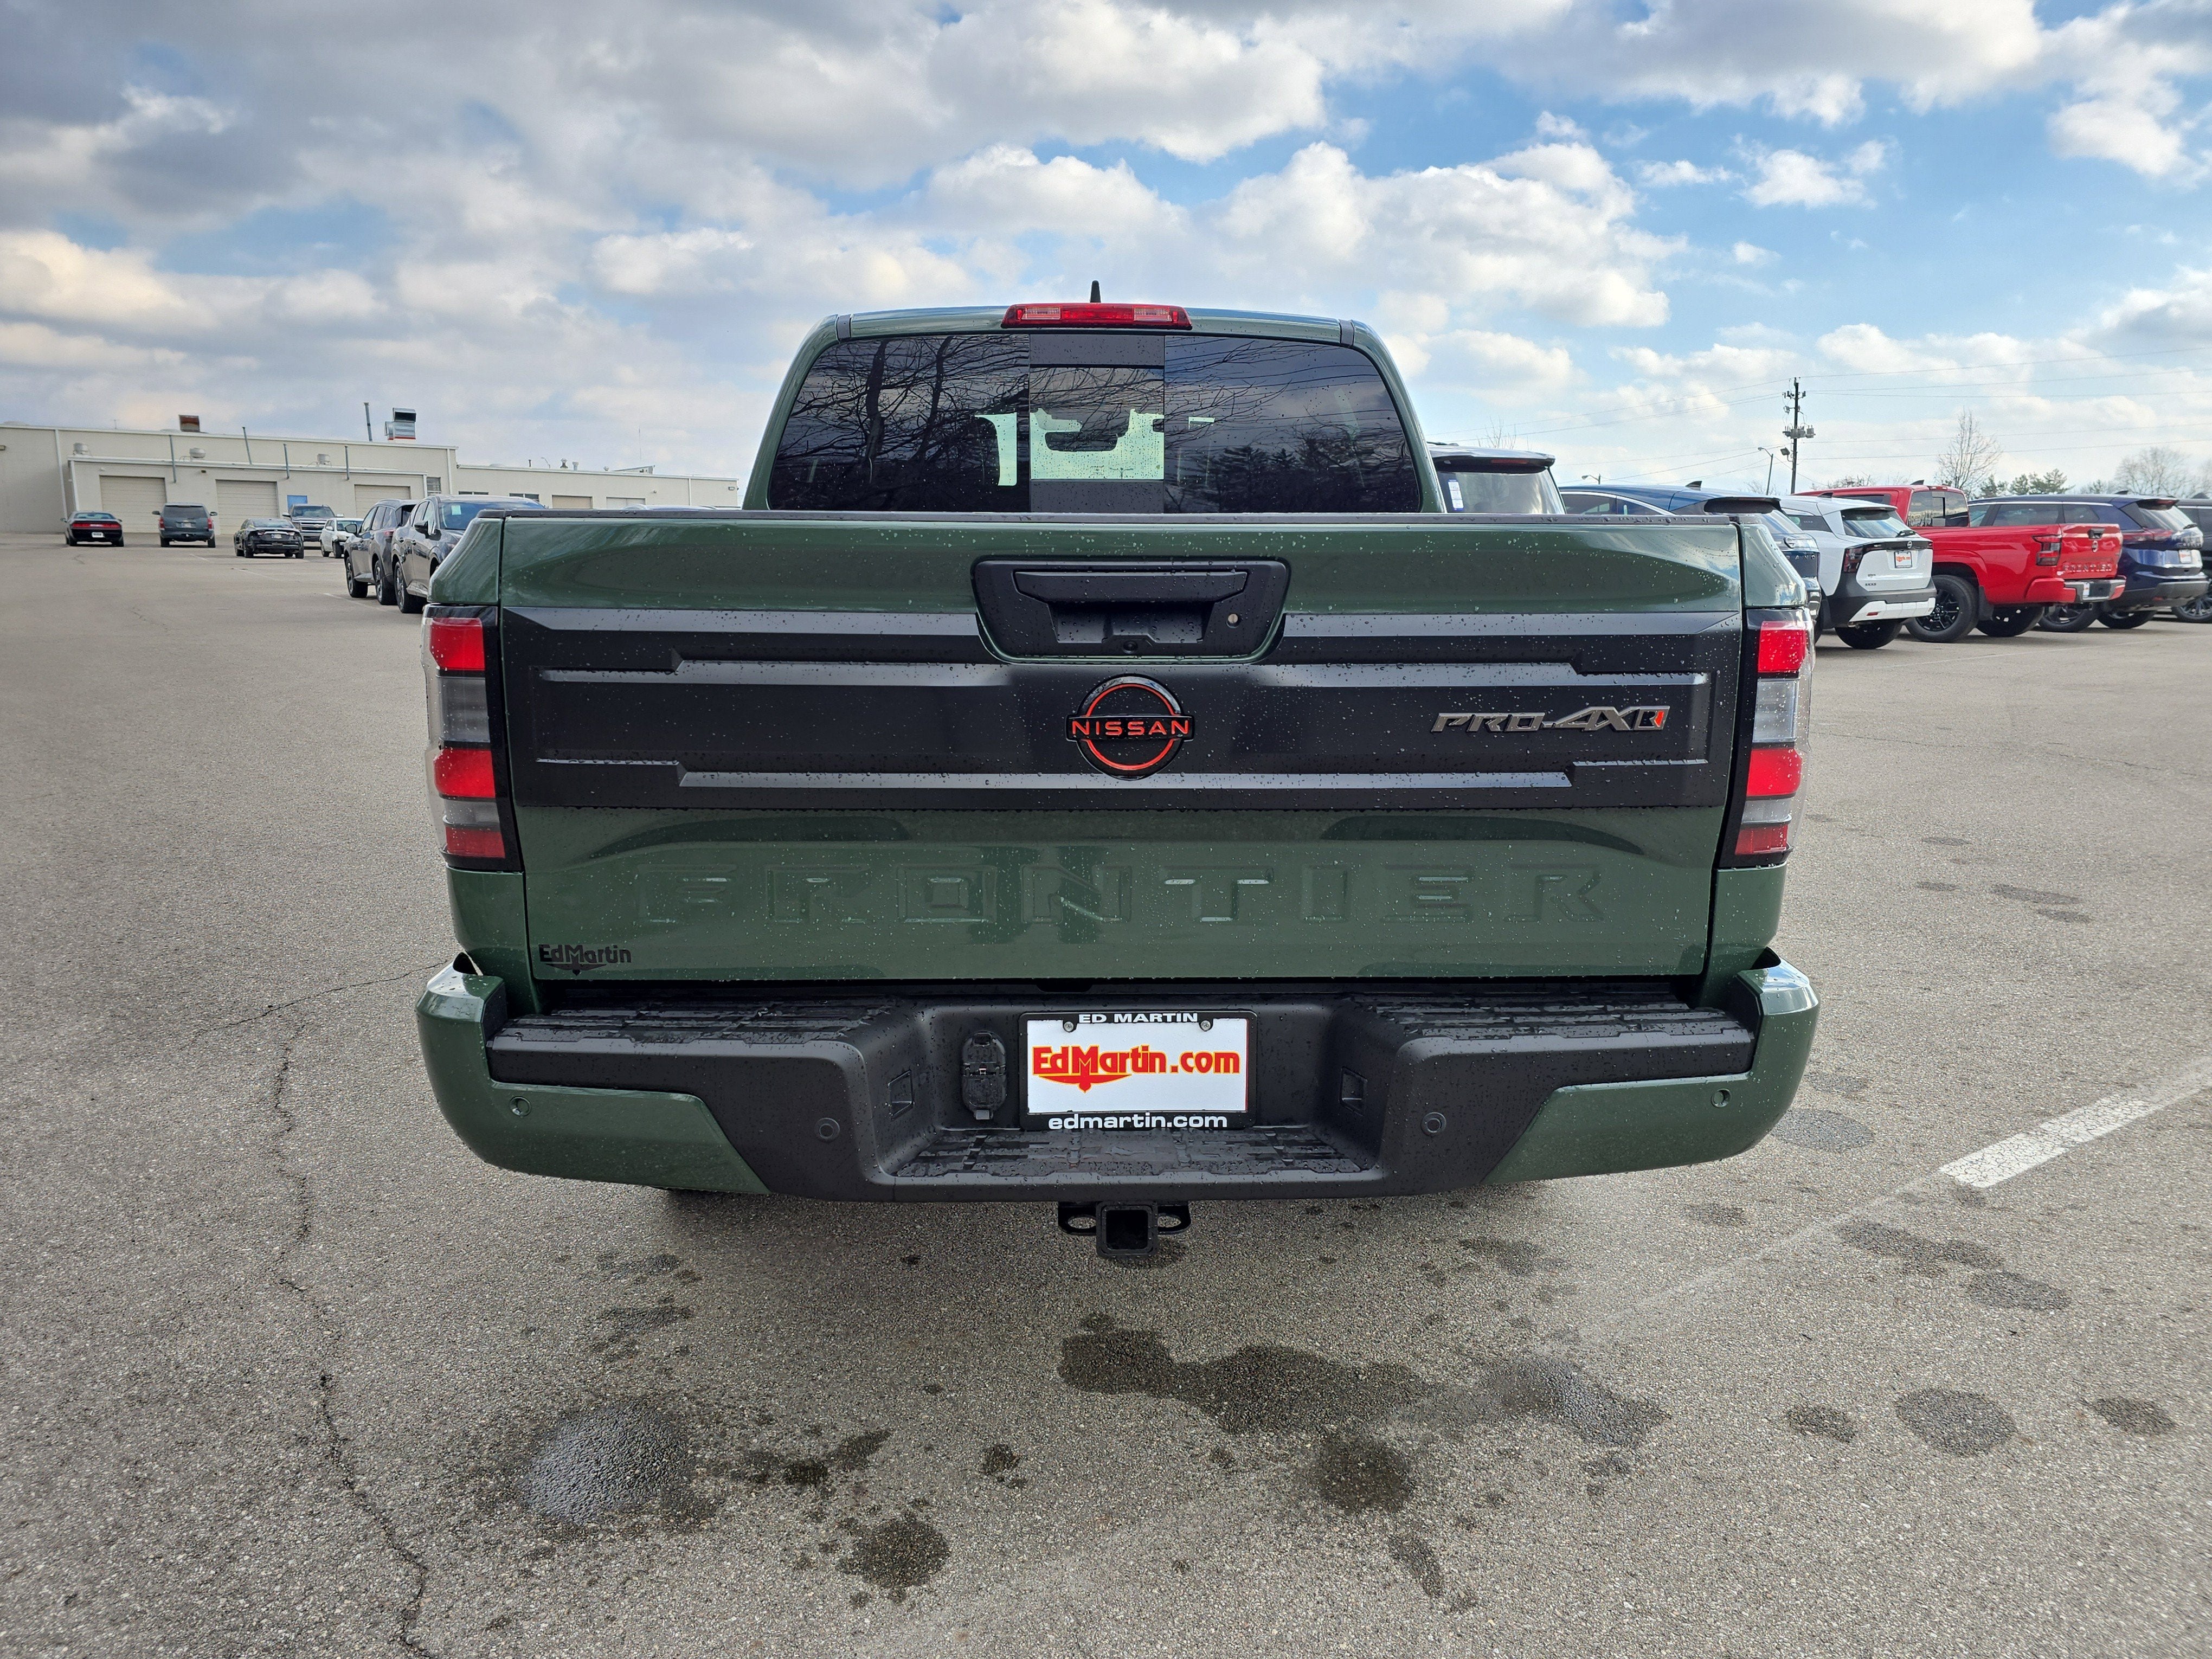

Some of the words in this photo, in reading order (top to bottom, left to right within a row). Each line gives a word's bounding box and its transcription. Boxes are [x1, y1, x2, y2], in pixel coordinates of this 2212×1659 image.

[1071, 720, 1188, 735] NISSAN
[637, 864, 1604, 924] FRONTIER
[538, 944, 632, 963] EdMartin
[1078, 1013, 1107, 1024] ED
[1114, 1012, 1198, 1023] MARTIN
[1032, 1045, 1241, 1075] EdMartin.com
[1048, 1112, 1228, 1129] edmartin.com
